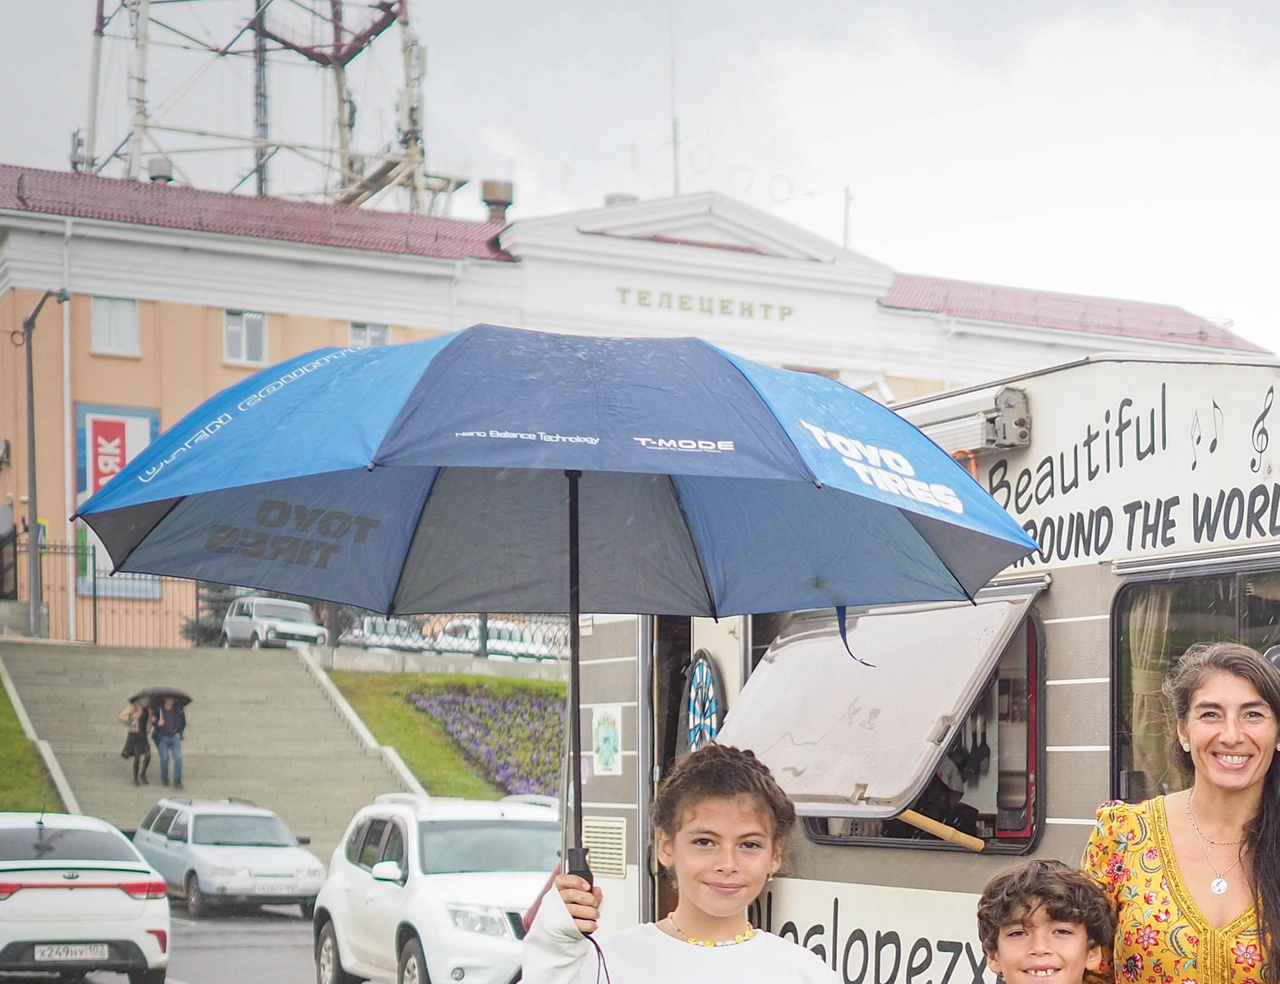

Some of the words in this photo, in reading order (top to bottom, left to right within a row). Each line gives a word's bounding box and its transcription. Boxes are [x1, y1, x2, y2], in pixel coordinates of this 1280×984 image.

[616, 287, 795, 322] ТЕЛЕЦЕНТР
[97, 434, 122, 488] ЯК
[455, 430, 487, 438] Nano
[488, 429, 537, 441] Balance
[537, 431, 600, 445] Technology
[633, 437, 735, 450] T-MODE
[800, 419, 915, 477] TOYO
[988, 382, 1168, 515] Beautiful
[841, 457, 964, 514] TIRES
[1012, 505, 1114, 568] ROUND
[1123, 496, 1181, 552] THE
